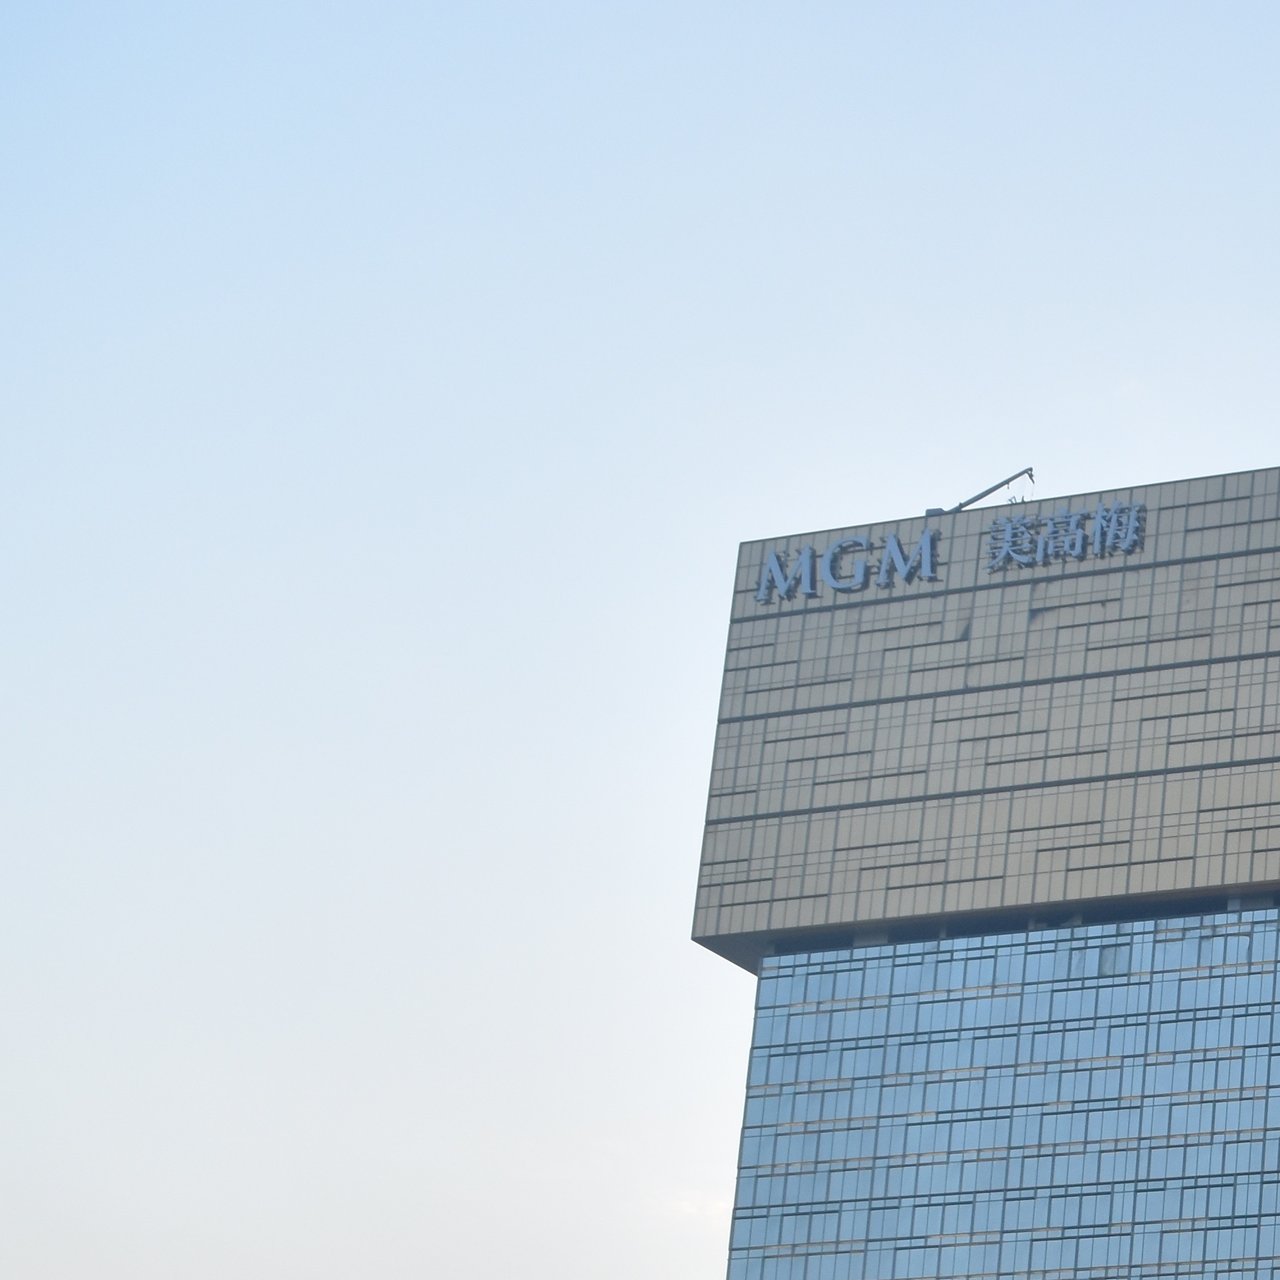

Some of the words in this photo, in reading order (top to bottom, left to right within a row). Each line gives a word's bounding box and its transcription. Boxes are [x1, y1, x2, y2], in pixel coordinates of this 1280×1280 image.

[755, 527, 941, 604] MGM
[986, 499, 1143, 573] 美高梅
